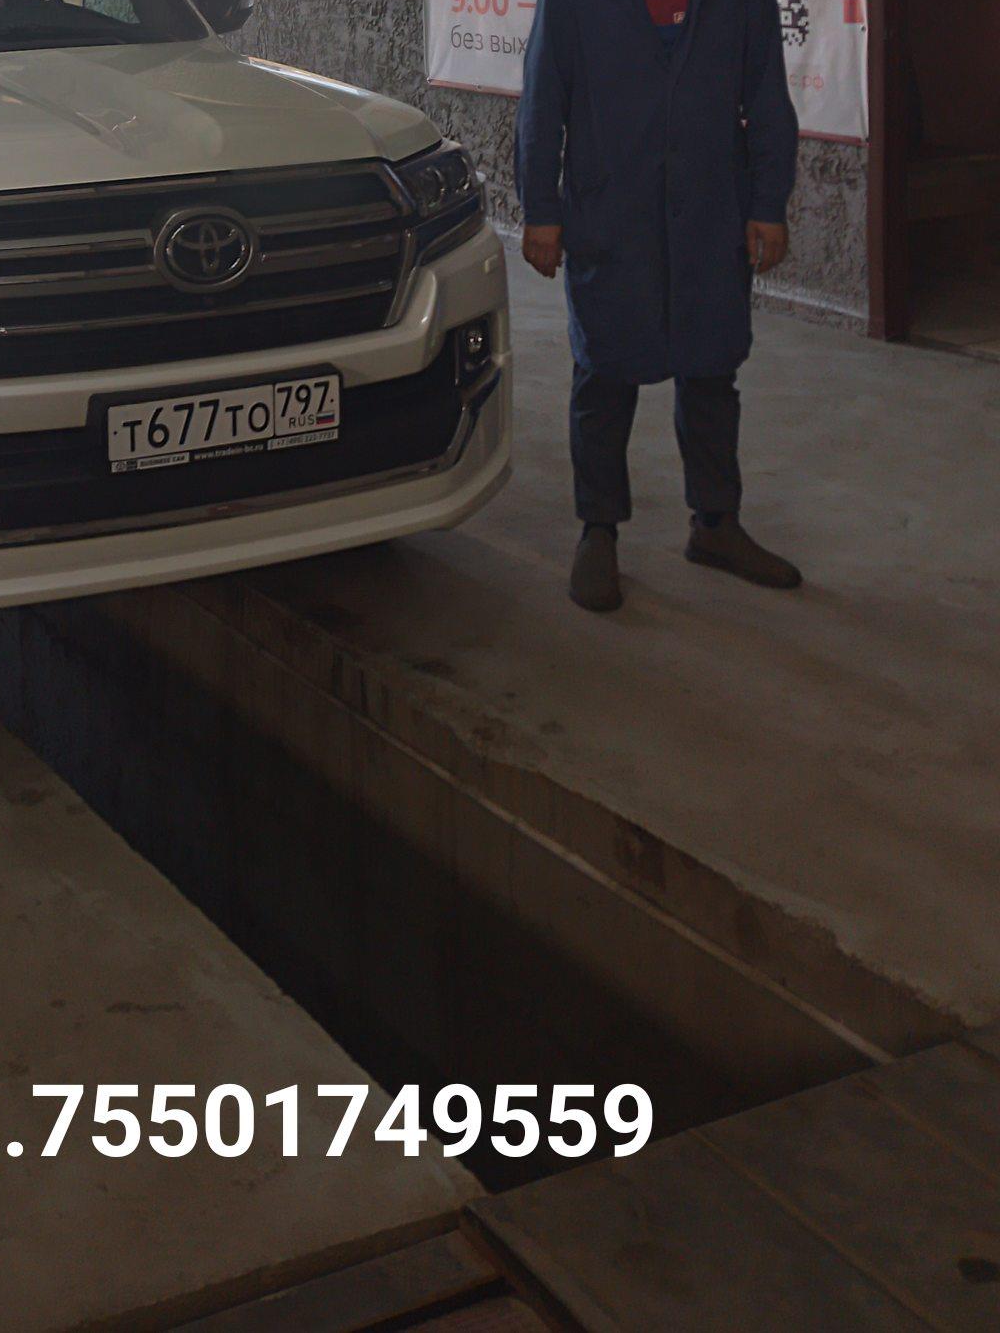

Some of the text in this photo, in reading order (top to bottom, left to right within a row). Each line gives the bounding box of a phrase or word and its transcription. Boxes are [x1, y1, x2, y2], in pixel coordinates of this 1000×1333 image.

[450, 24, 484, 51] без
[122, 380, 331, 453] Т677ТО 797
[288, 413, 316, 429] RUS
